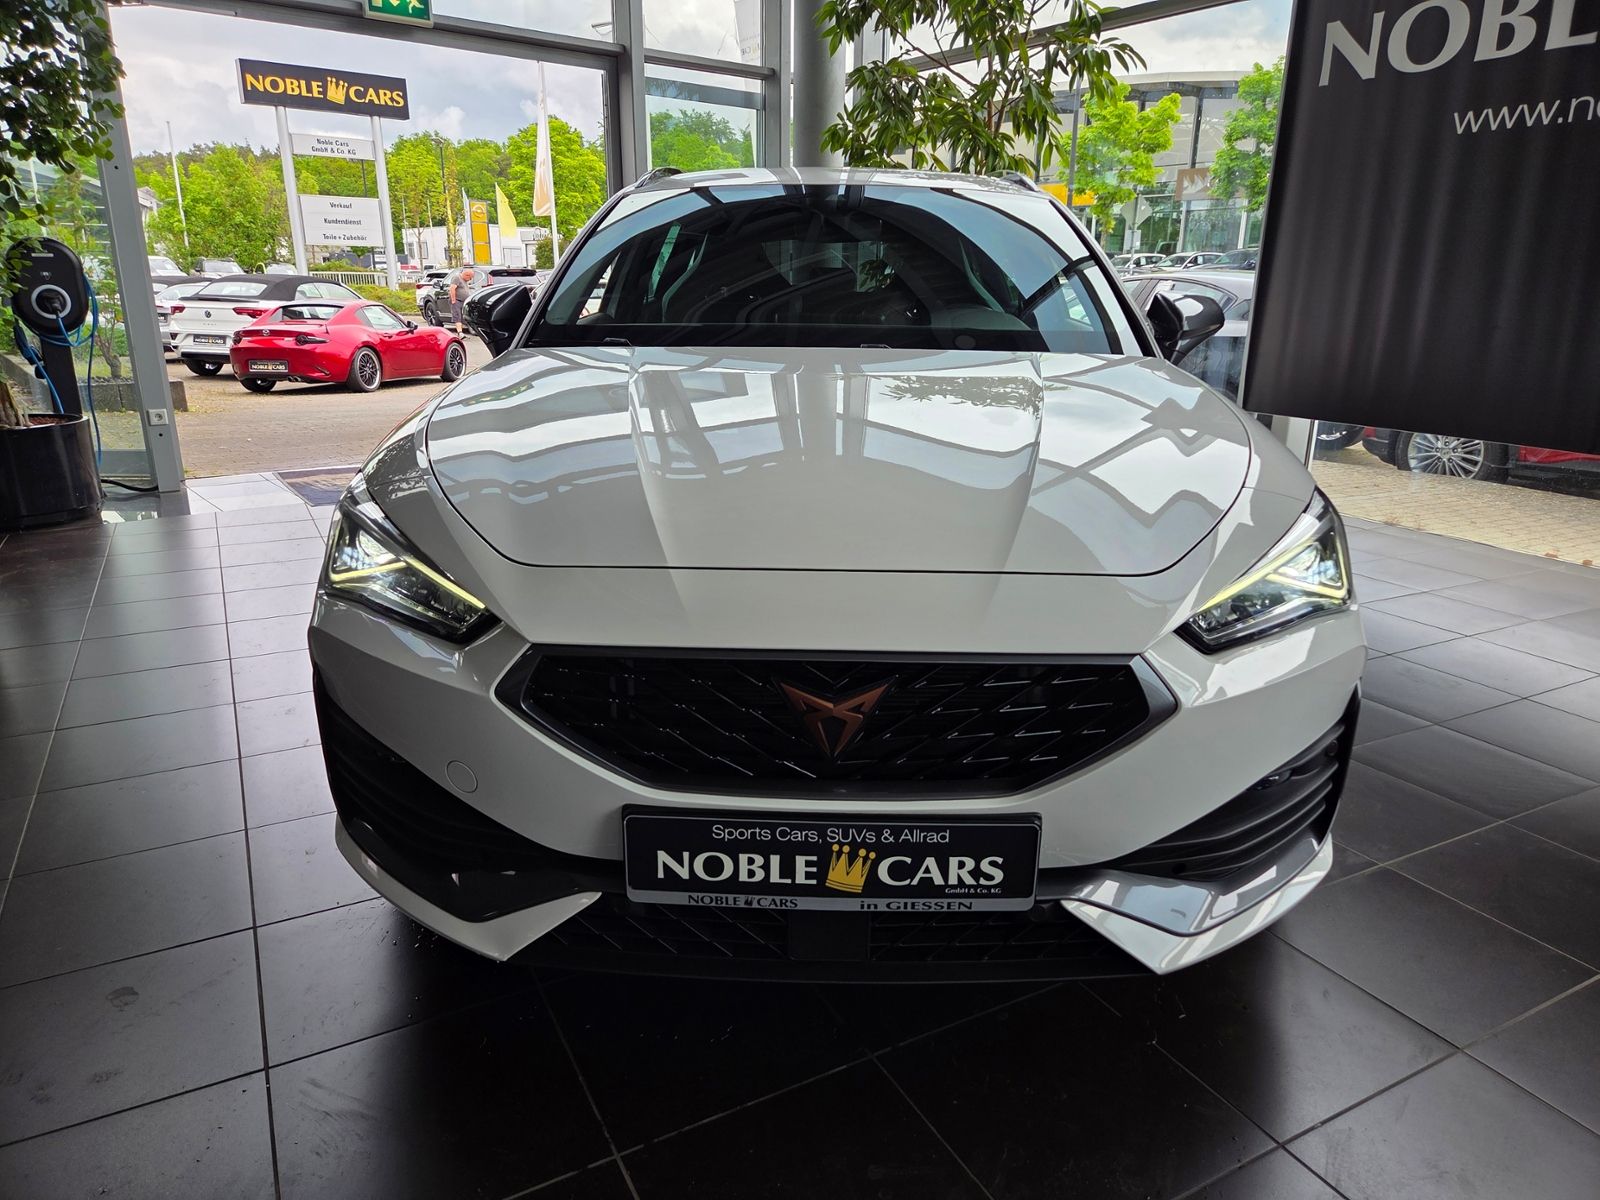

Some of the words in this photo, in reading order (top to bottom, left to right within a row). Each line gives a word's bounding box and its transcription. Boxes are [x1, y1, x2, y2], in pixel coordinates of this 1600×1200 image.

[1319, 0, 1598, 87] NOBL
[245, 73, 324, 98] NOBLE
[348, 85, 405, 107] CARS
[1454, 95, 1600, 135] www.n
[311, 145, 328, 153] GmbH
[316, 138, 333, 146] Noble
[329, 201, 352, 209] Verkauf
[323, 217, 362, 225] Kundendienst
[712, 824, 771, 842] Sports
[776, 826, 823, 843] Cars,
[826, 827, 876, 843] SUVs
[881, 828, 895, 843] &
[899, 829, 950, 843] Allrad
[656, 850, 818, 885] NOBLE
[877, 856, 1004, 886] CARS
[687, 894, 741, 906] NOBLE
[756, 897, 798, 909] CARS
[860, 900, 878, 910] in
[886, 901, 973, 910] GIESSEN
